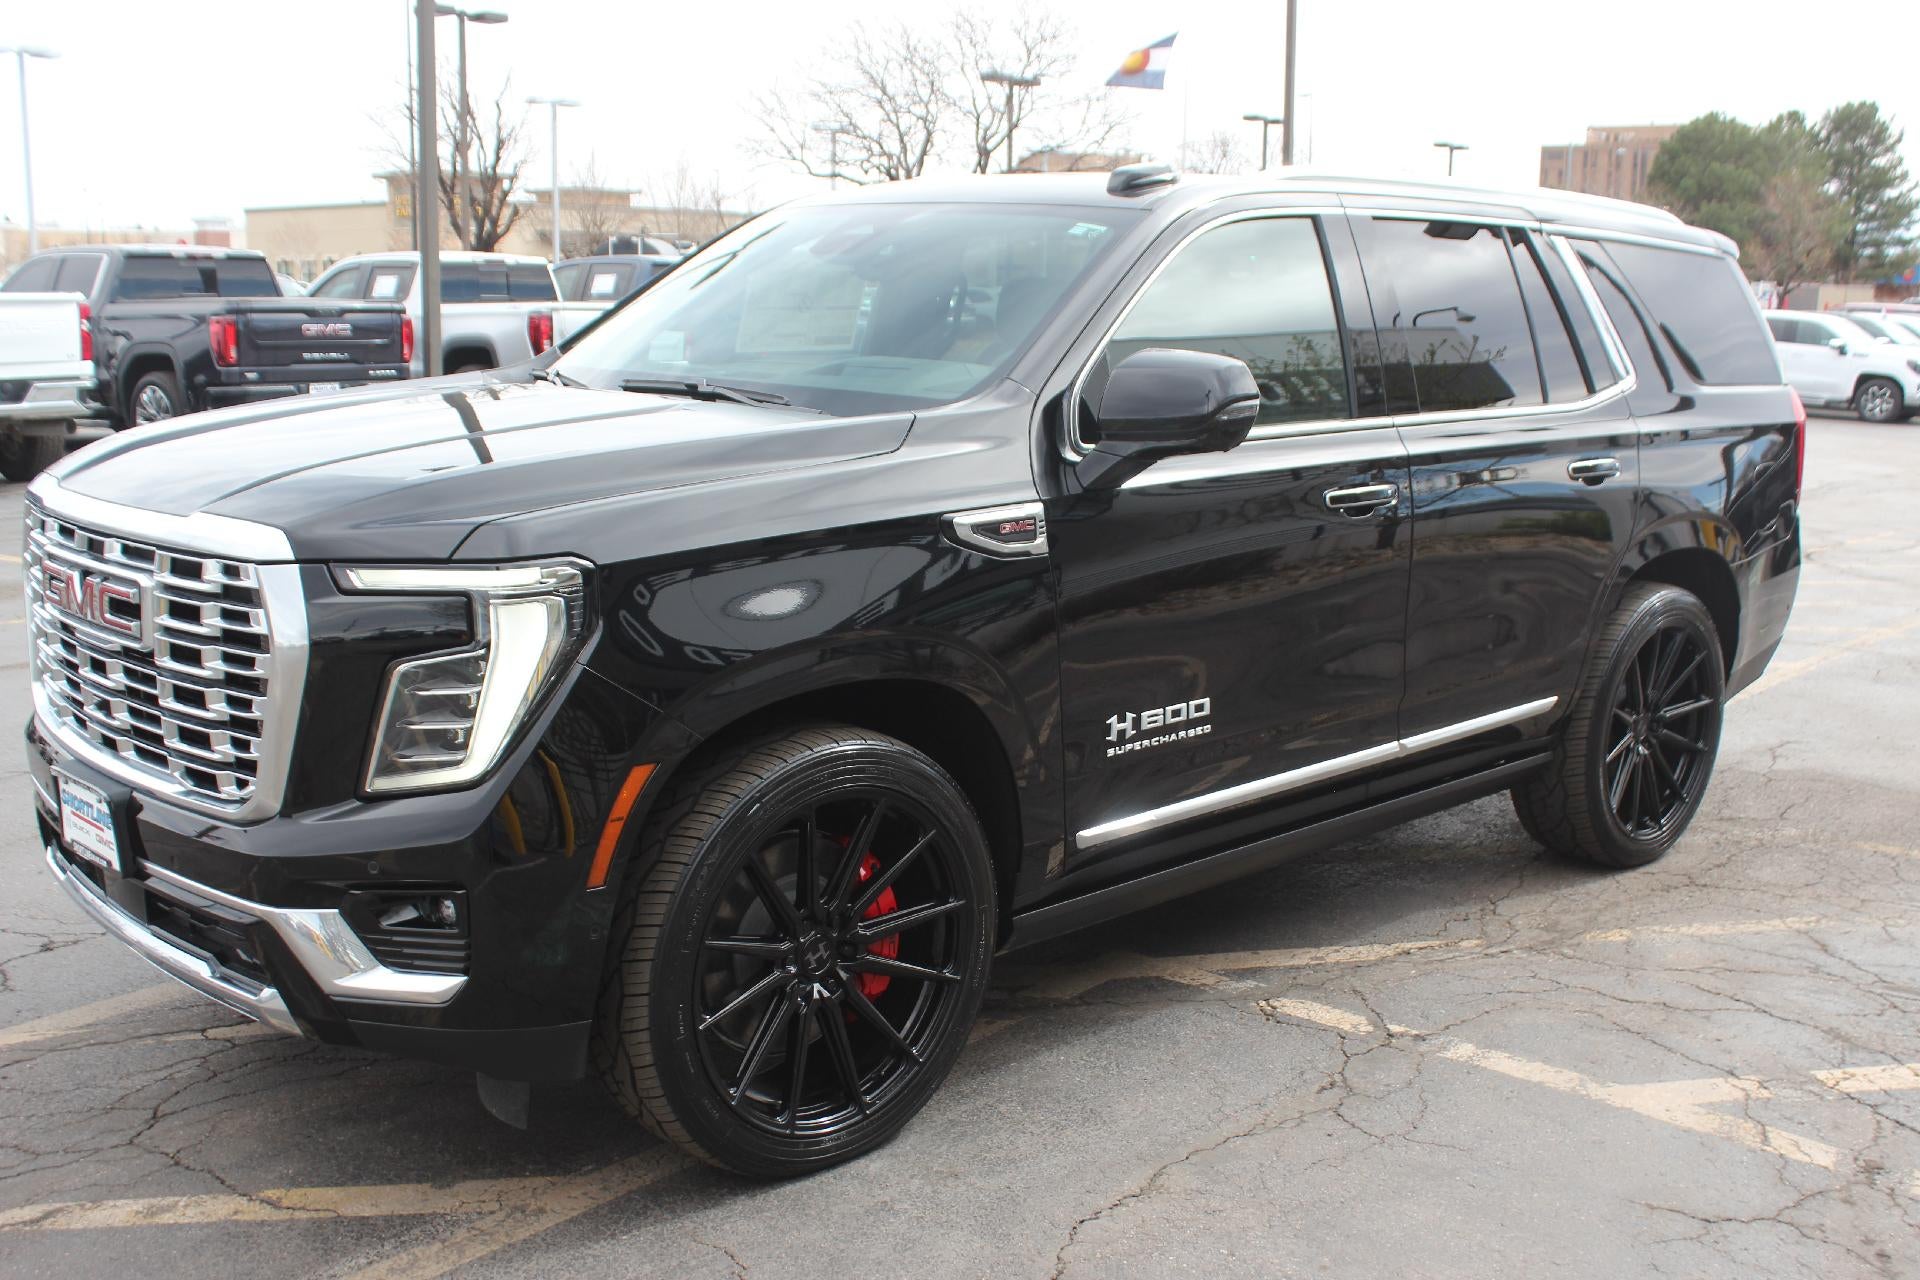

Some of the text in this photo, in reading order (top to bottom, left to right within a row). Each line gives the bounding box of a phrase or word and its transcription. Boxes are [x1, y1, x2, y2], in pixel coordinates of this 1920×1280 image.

[301, 323, 353, 337] GMC
[1000, 519, 1035, 534] GMC
[42, 560, 140, 637] GMC
[1106, 724, 1212, 758] SUPERCHARGED
